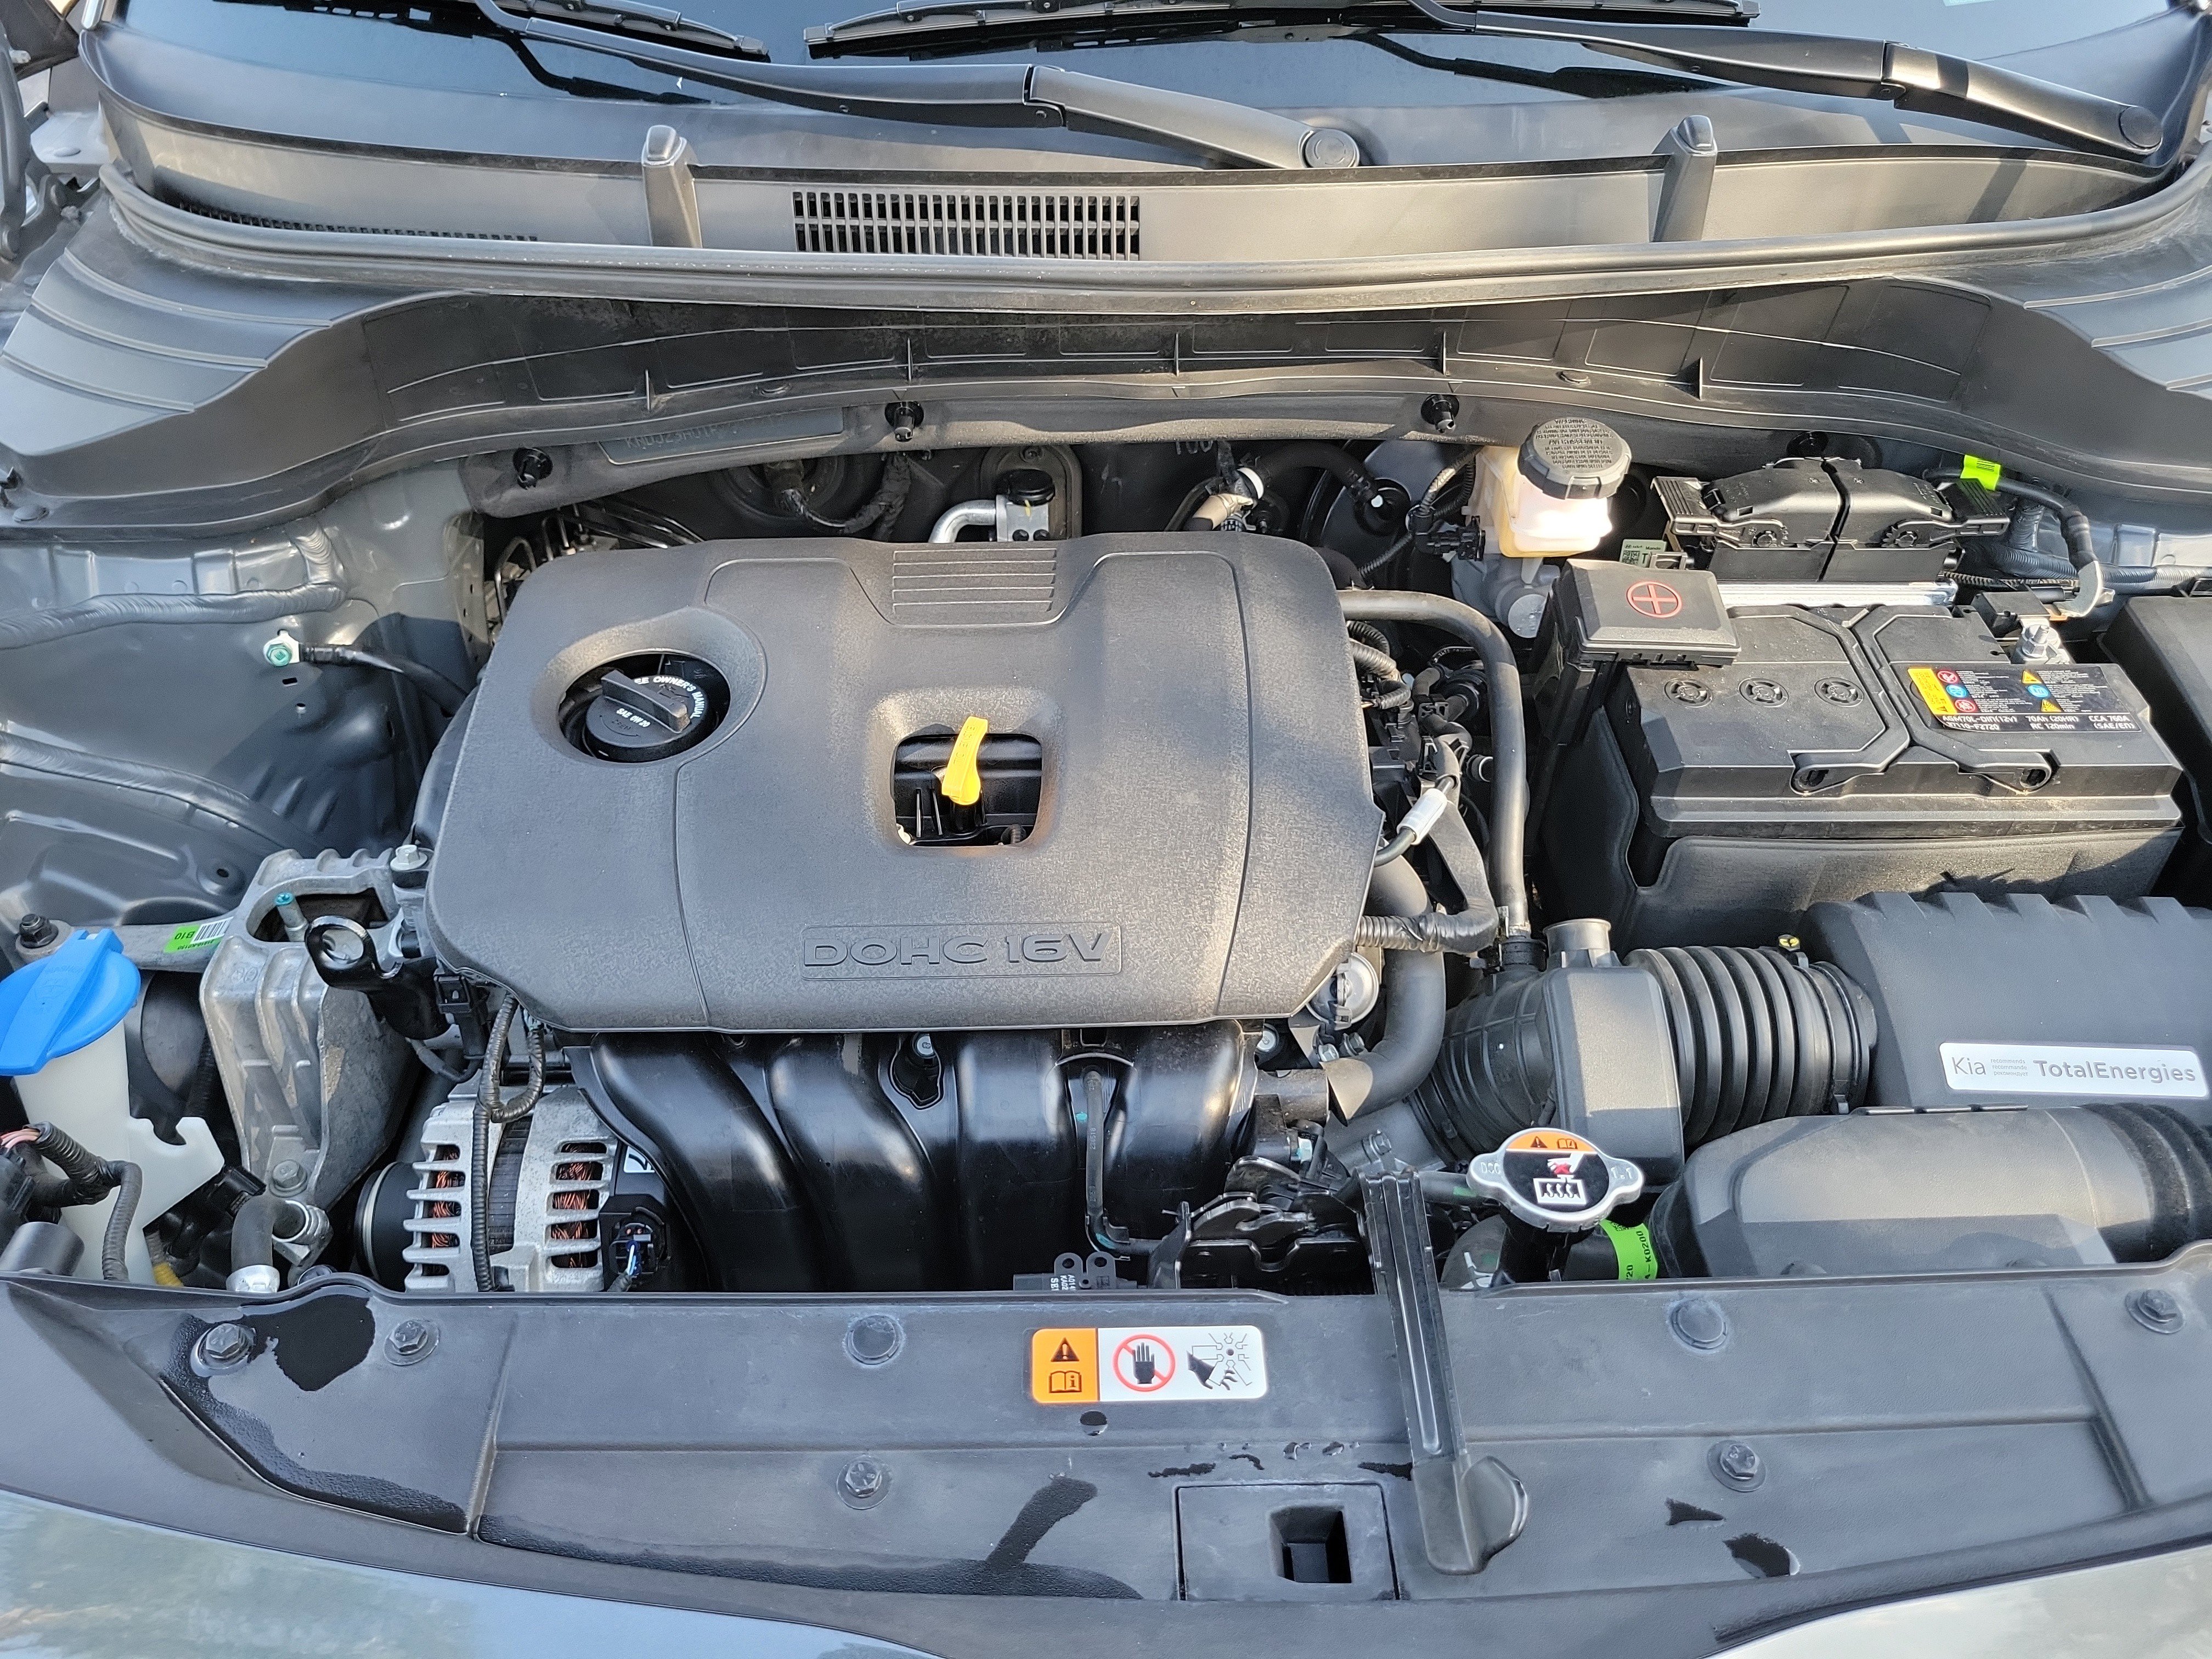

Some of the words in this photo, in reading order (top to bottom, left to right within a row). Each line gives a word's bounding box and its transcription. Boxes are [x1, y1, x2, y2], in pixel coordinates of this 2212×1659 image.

[653, 676, 697, 692] OWNER'S
[690, 691, 706, 719] MANUAL
[616, 708, 633, 718] SAE
[174, 931, 196, 940] B10
[804, 936, 989, 967] DOHC
[1005, 932, 1114, 963] 16V
[1951, 1057, 1987, 1075] Kia
[2033, 1060, 2196, 1084] TotalEnergies
